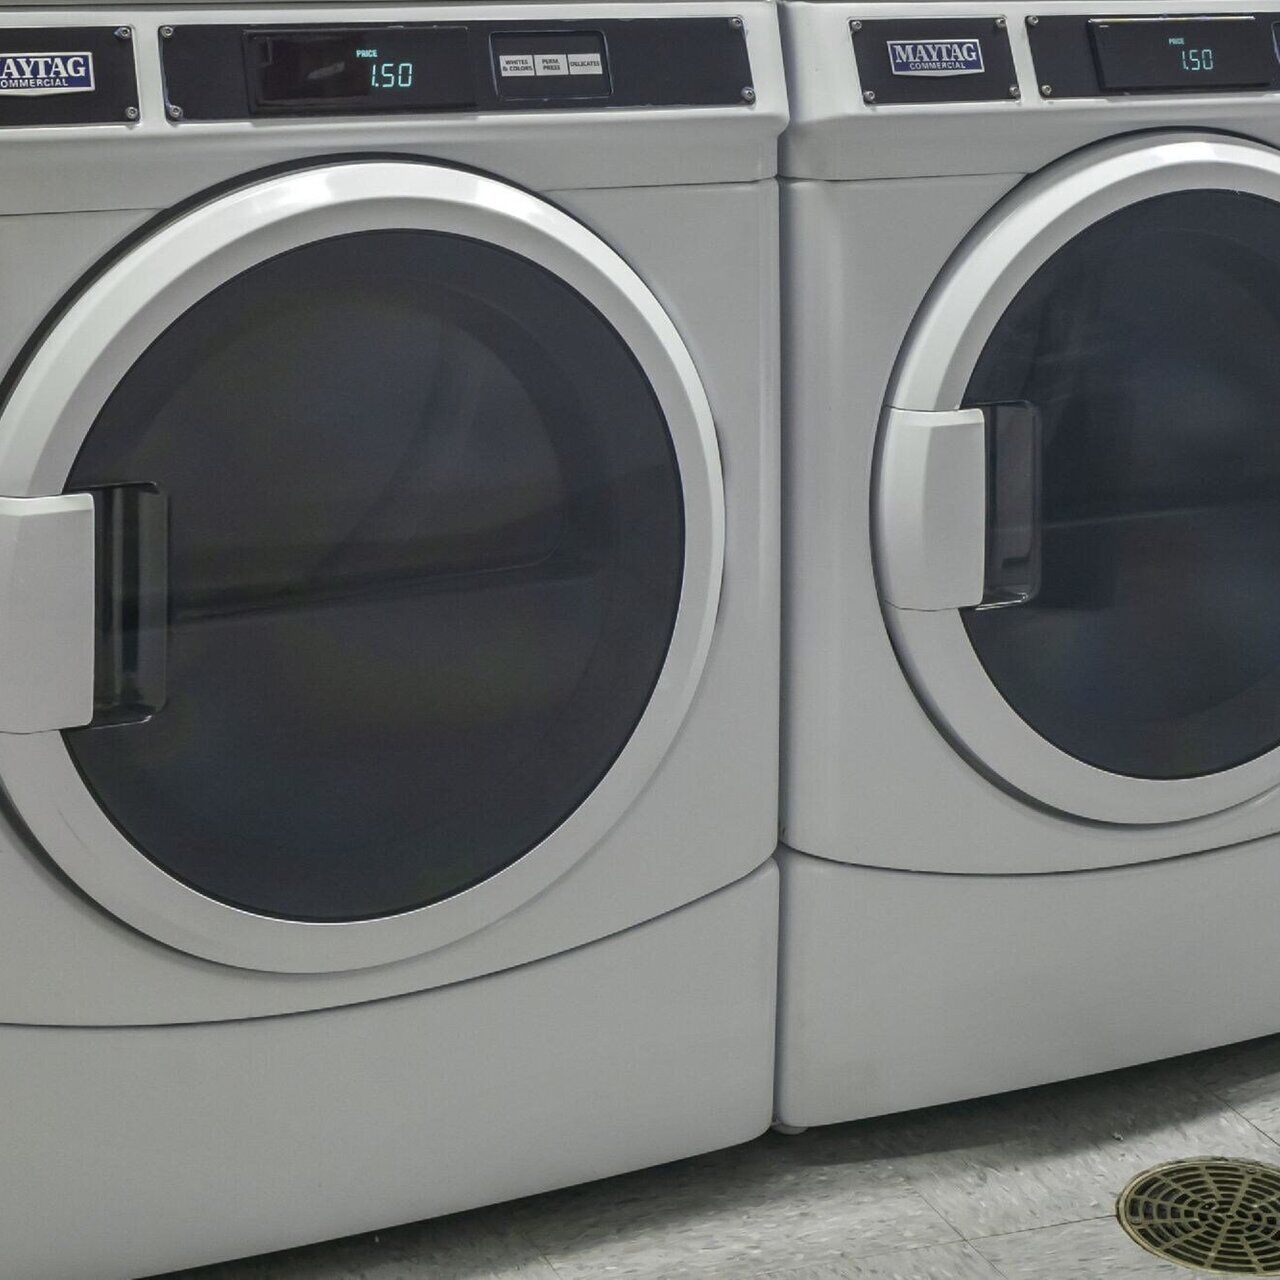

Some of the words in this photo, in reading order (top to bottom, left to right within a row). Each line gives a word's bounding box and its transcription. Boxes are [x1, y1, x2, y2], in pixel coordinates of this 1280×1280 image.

[356, 50, 378, 58] PRICE
[893, 43, 977, 63] MAYTAG
[1182, 49, 1214, 70] 1.50
[371, 63, 413, 87] 1.50
[909, 61, 966, 70] COMMERCIAL
